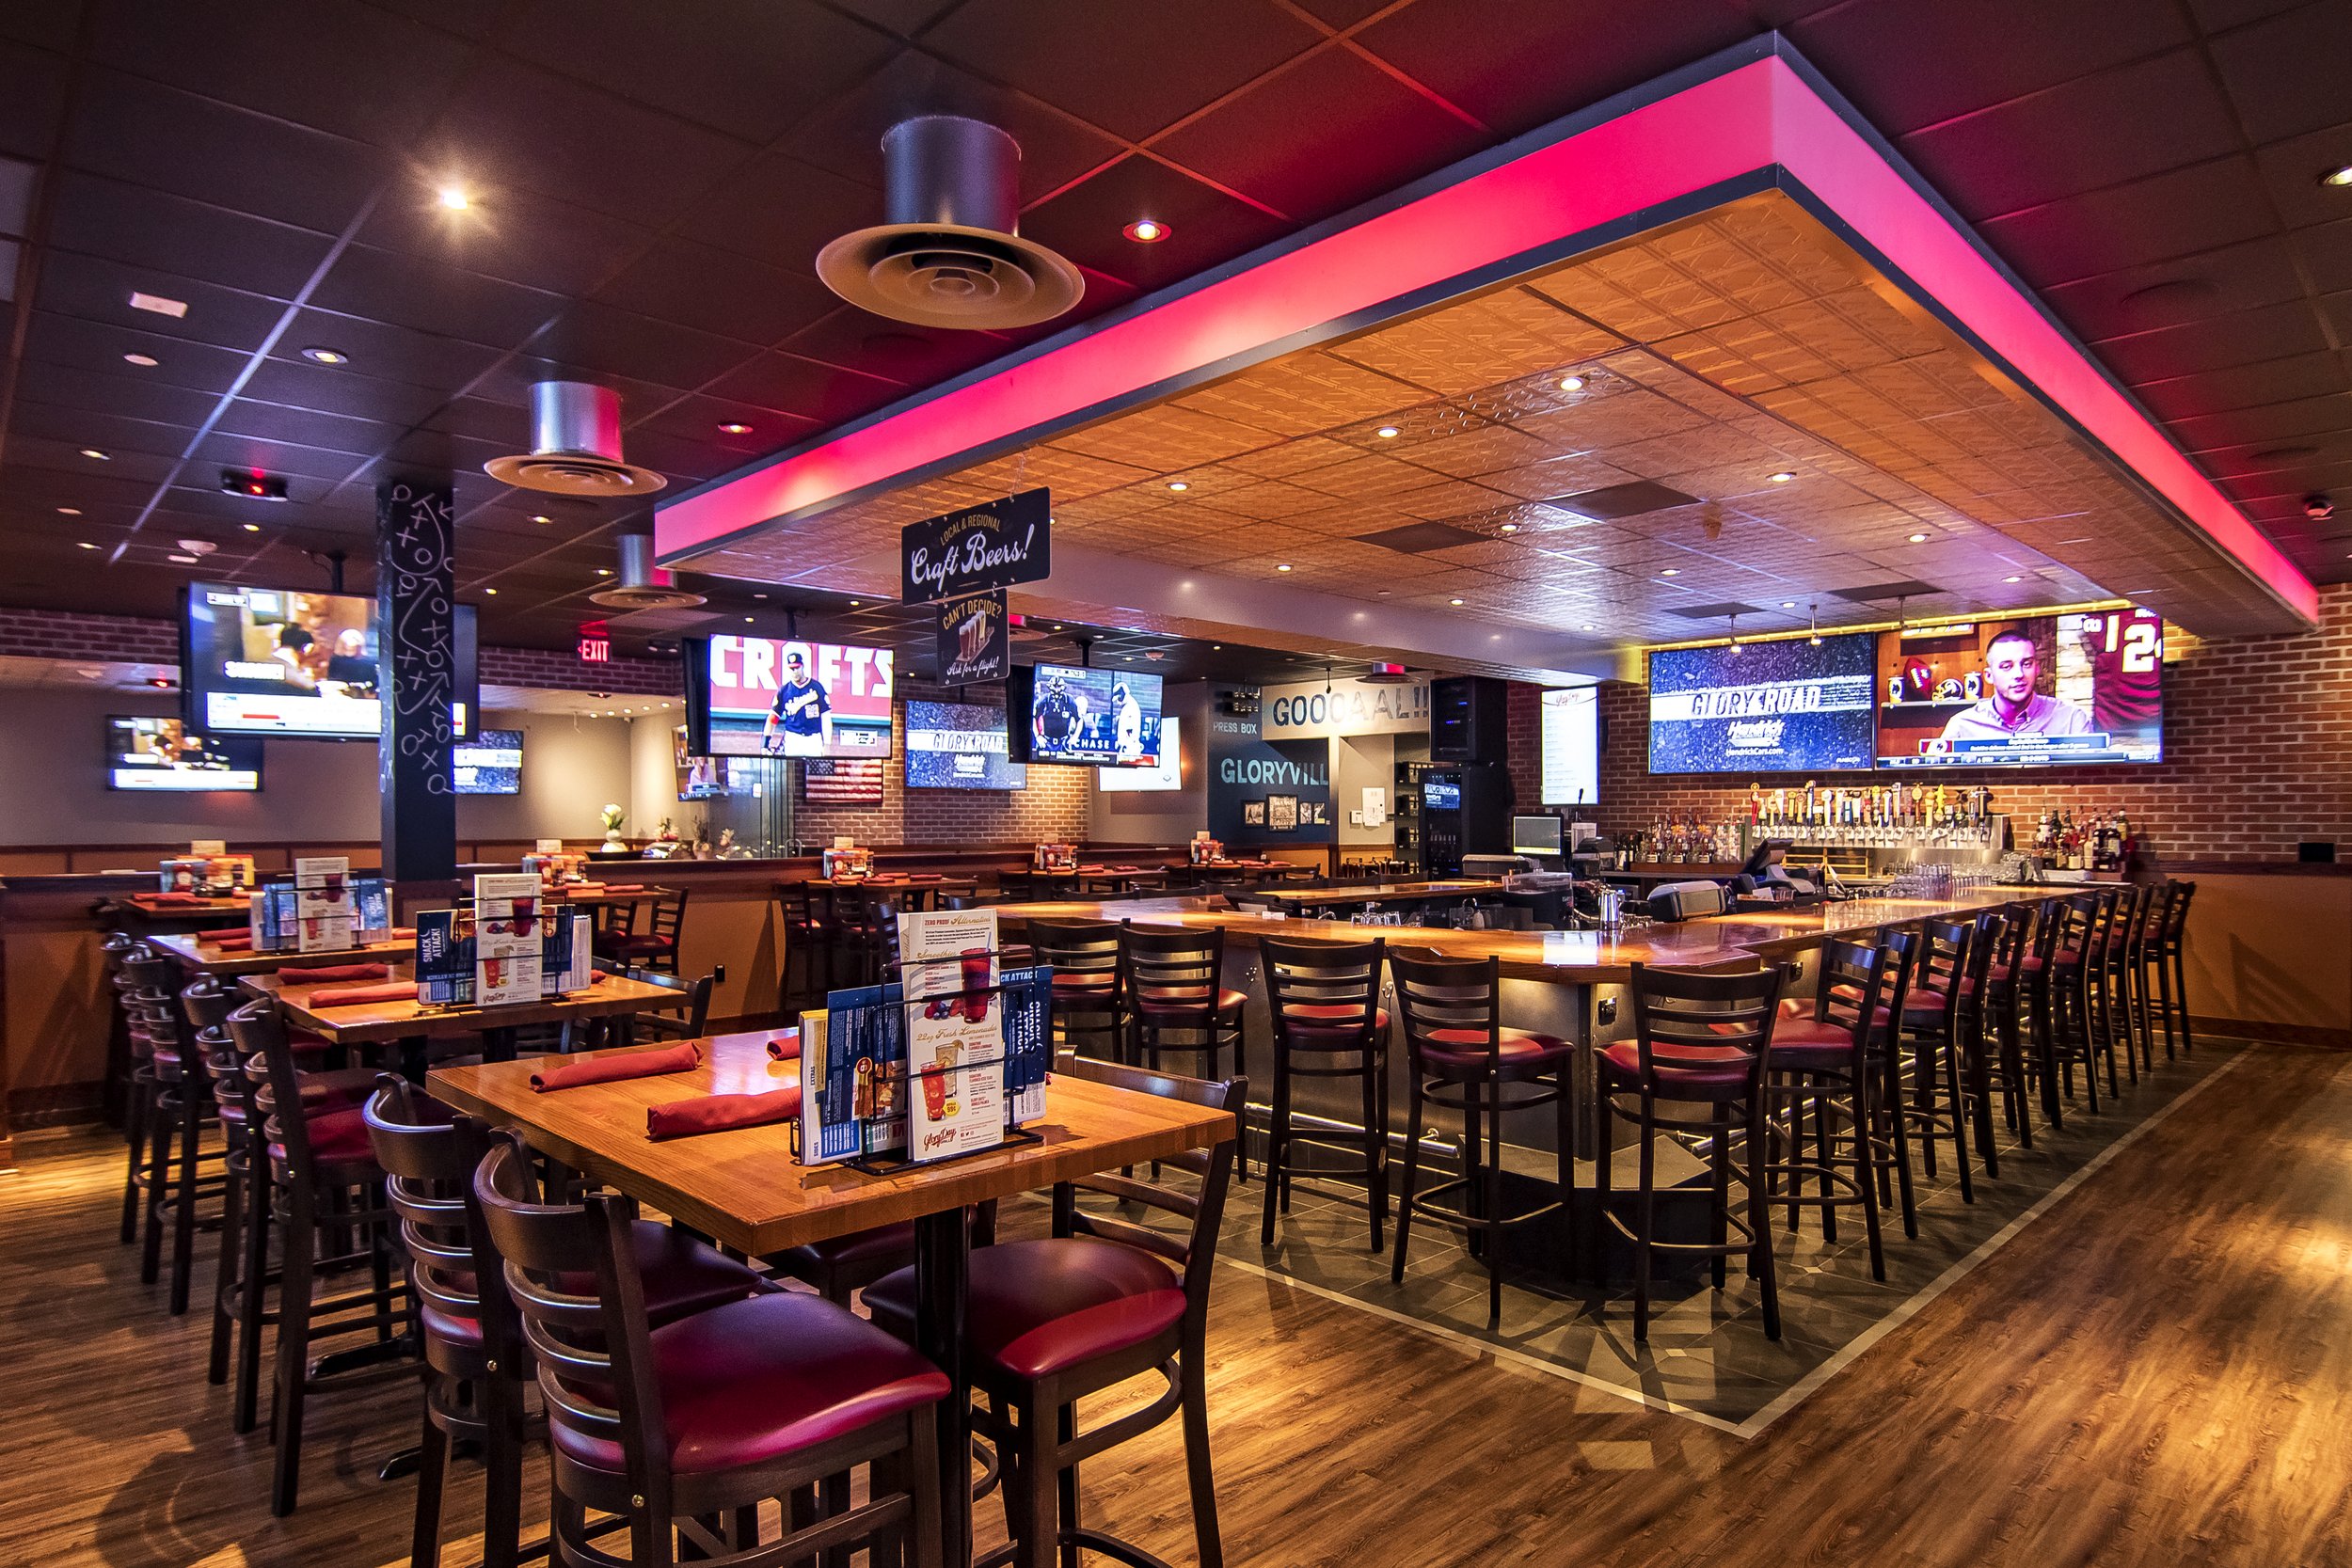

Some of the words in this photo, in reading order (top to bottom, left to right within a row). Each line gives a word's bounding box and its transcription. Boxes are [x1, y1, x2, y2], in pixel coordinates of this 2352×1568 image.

[940, 524, 961, 546] LOCAL
[961, 518, 967, 531] &
[967, 514, 1000, 532] REGIONAL
[911, 545, 960, 593] Craft
[961, 523, 1035, 574] Beers!
[943, 602, 965, 630] CAN'T
[967, 598, 1002, 619] DECIDE?
[581, 640, 610, 662] EXIT
[946, 662, 961, 675] Ask
[961, 662, 971, 677] for
[977, 656, 999, 677] flight!
[1762, 686, 1821, 714] ROAD
[1214, 721, 1238, 733] PRESS
[1241, 723, 1258, 734] BOX
[1074, 738, 1110, 750] CHASE
[1221, 757, 1328, 785] GLORYVILL
[422, 938, 433, 963] SNACK
[431, 927, 443, 958] ATTACK!
